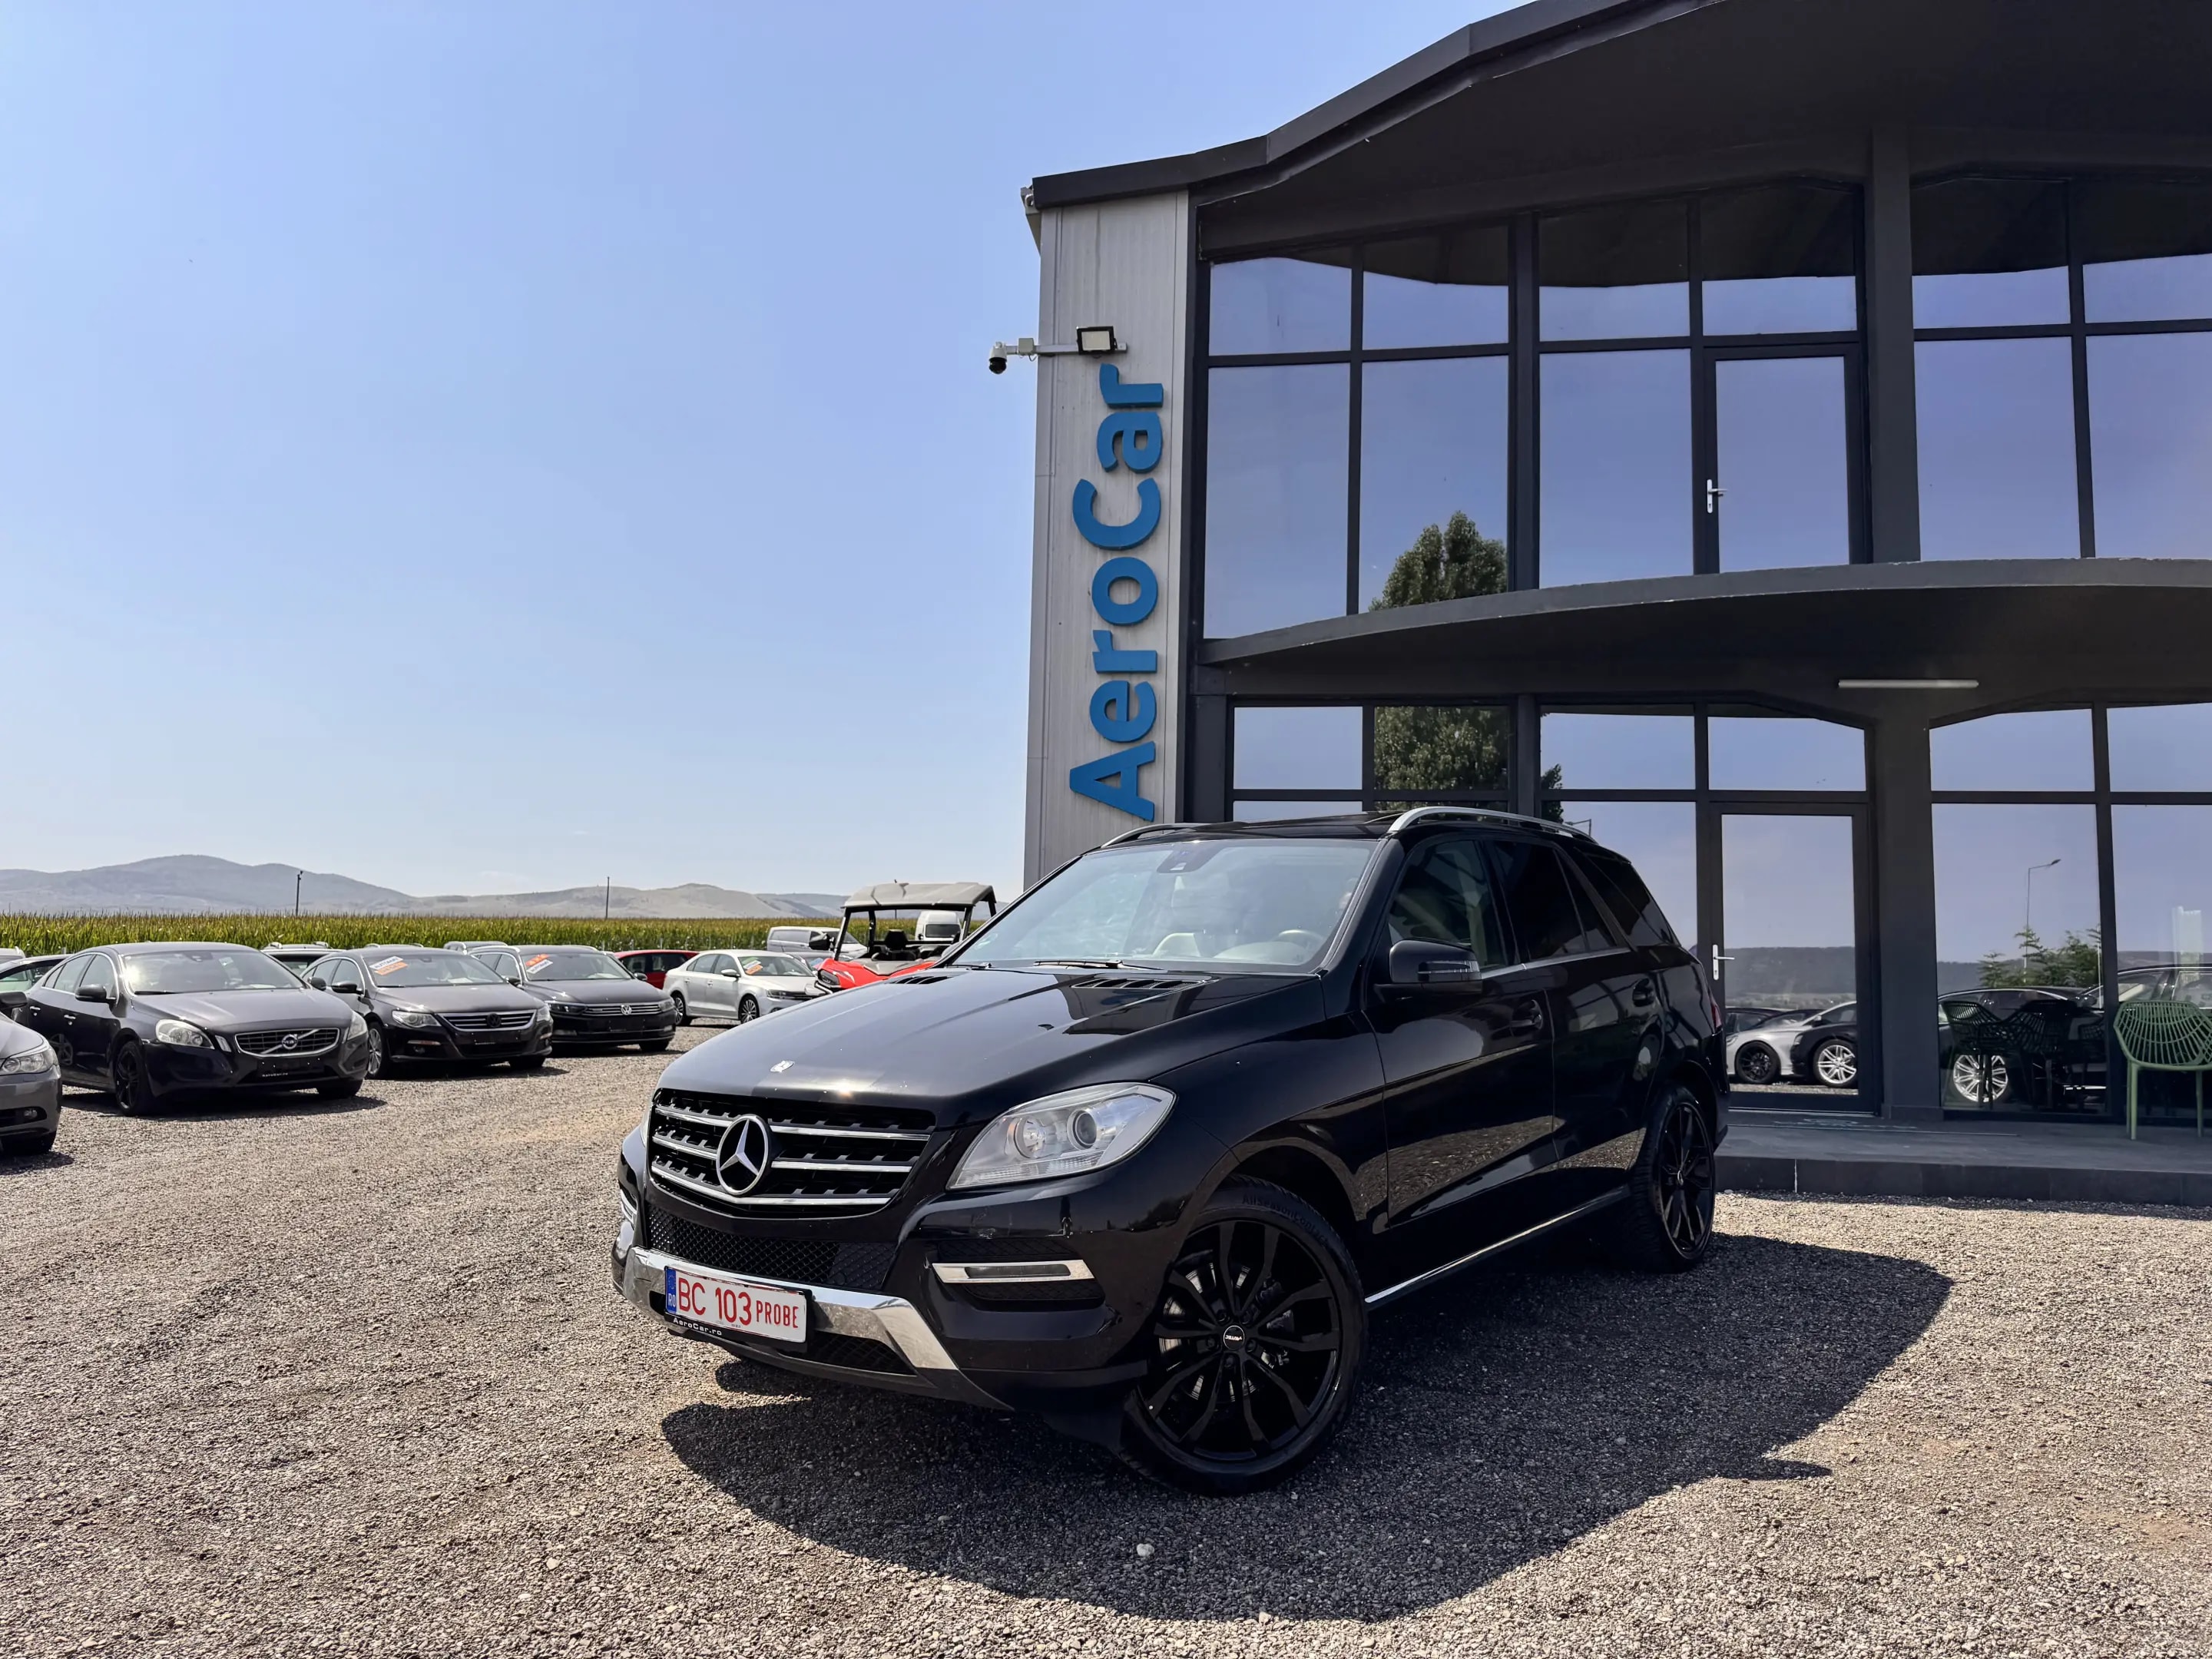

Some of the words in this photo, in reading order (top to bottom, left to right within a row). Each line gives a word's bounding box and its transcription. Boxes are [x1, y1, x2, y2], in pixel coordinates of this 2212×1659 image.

[1069, 363, 1164, 822] AeroCar
[668, 1293, 676, 1307] RO
[678, 1277, 706, 1316] BC
[715, 1287, 752, 1326] 103
[756, 1300, 800, 1329] PROBE
[673, 1317, 722, 1336] AeroCar.ro
